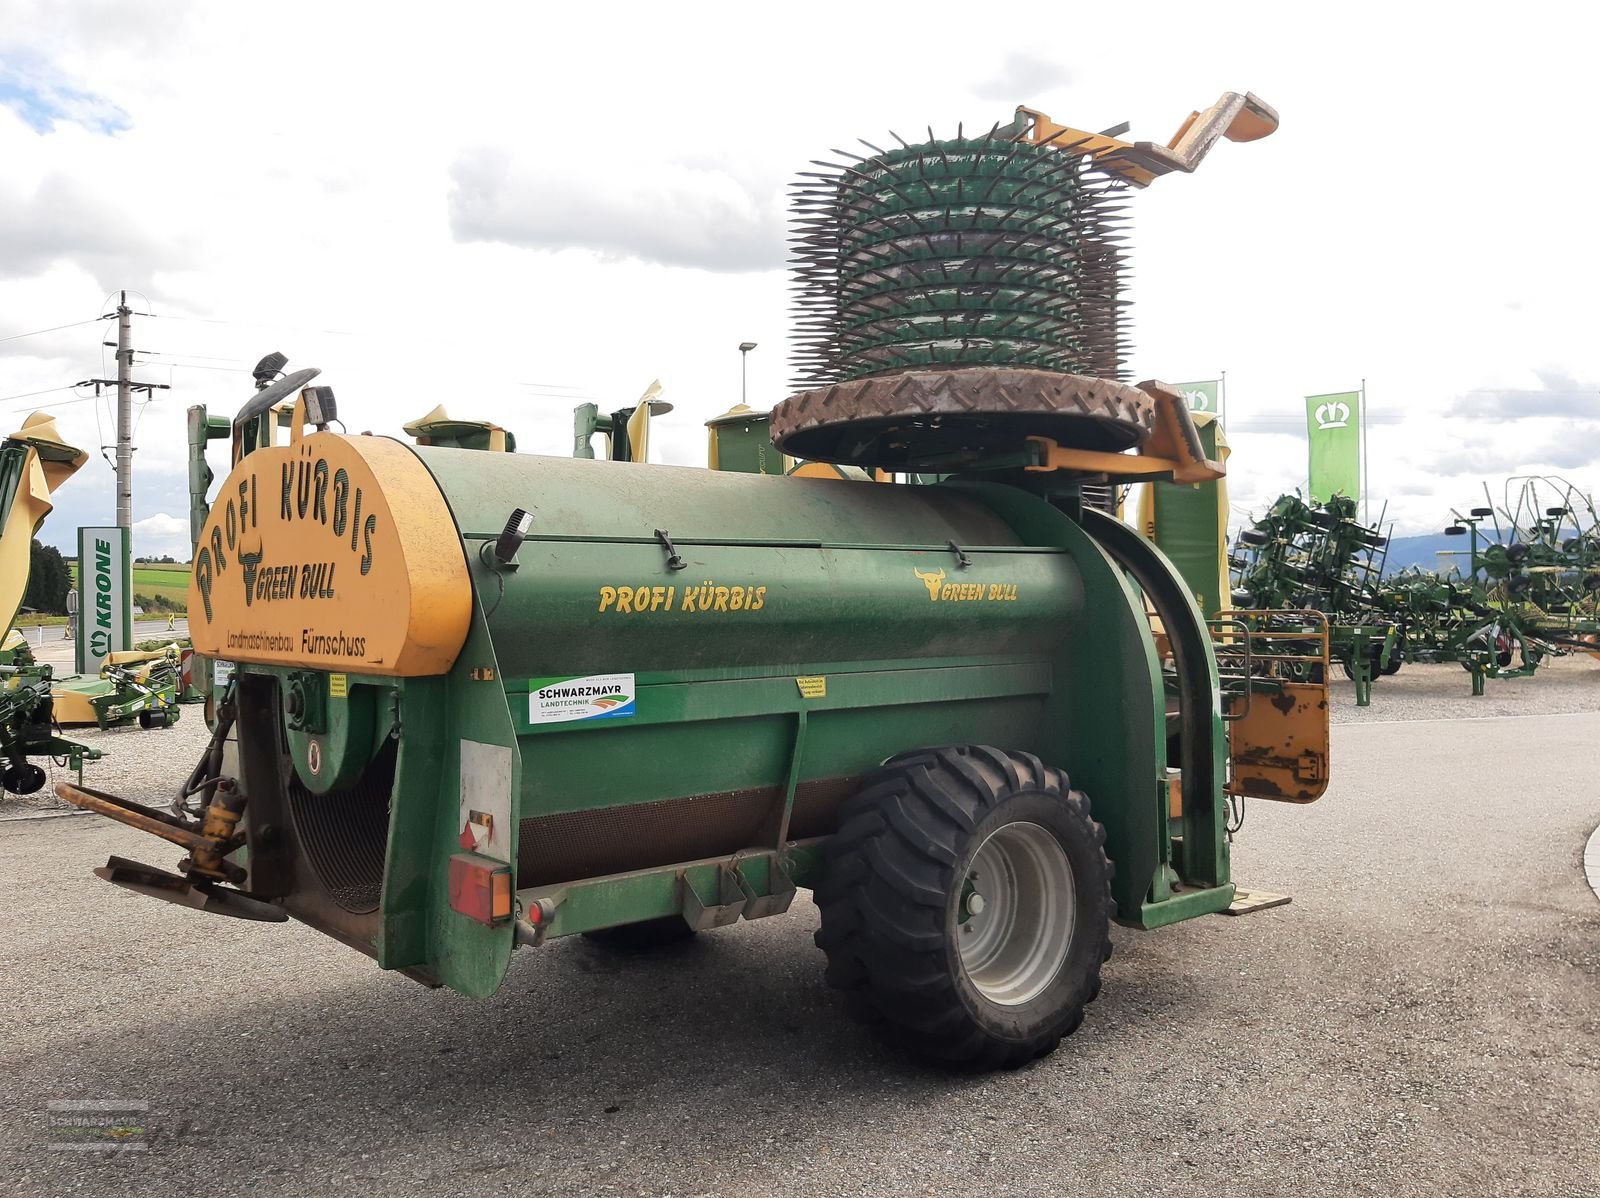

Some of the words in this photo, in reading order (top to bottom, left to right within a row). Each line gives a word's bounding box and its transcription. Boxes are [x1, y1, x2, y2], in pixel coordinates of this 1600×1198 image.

[196, 473, 257, 624] PROFI
[281, 445, 376, 576] KÜRBIS
[95, 538, 112, 629] KRONE
[256, 565, 298, 602] GREEN
[300, 562, 335, 600] BULL
[598, 586, 676, 614] PROFI
[681, 580, 767, 613] KÜRBIS
[941, 583, 986, 602] GREEN
[988, 583, 1017, 601] BULL
[227, 630, 294, 652] Landmaschinenbau
[301, 628, 366, 657] Fürnschuss
[538, 685, 621, 699] SCHWARZMAYR
[540, 699, 590, 708] LANDTECHNIK
